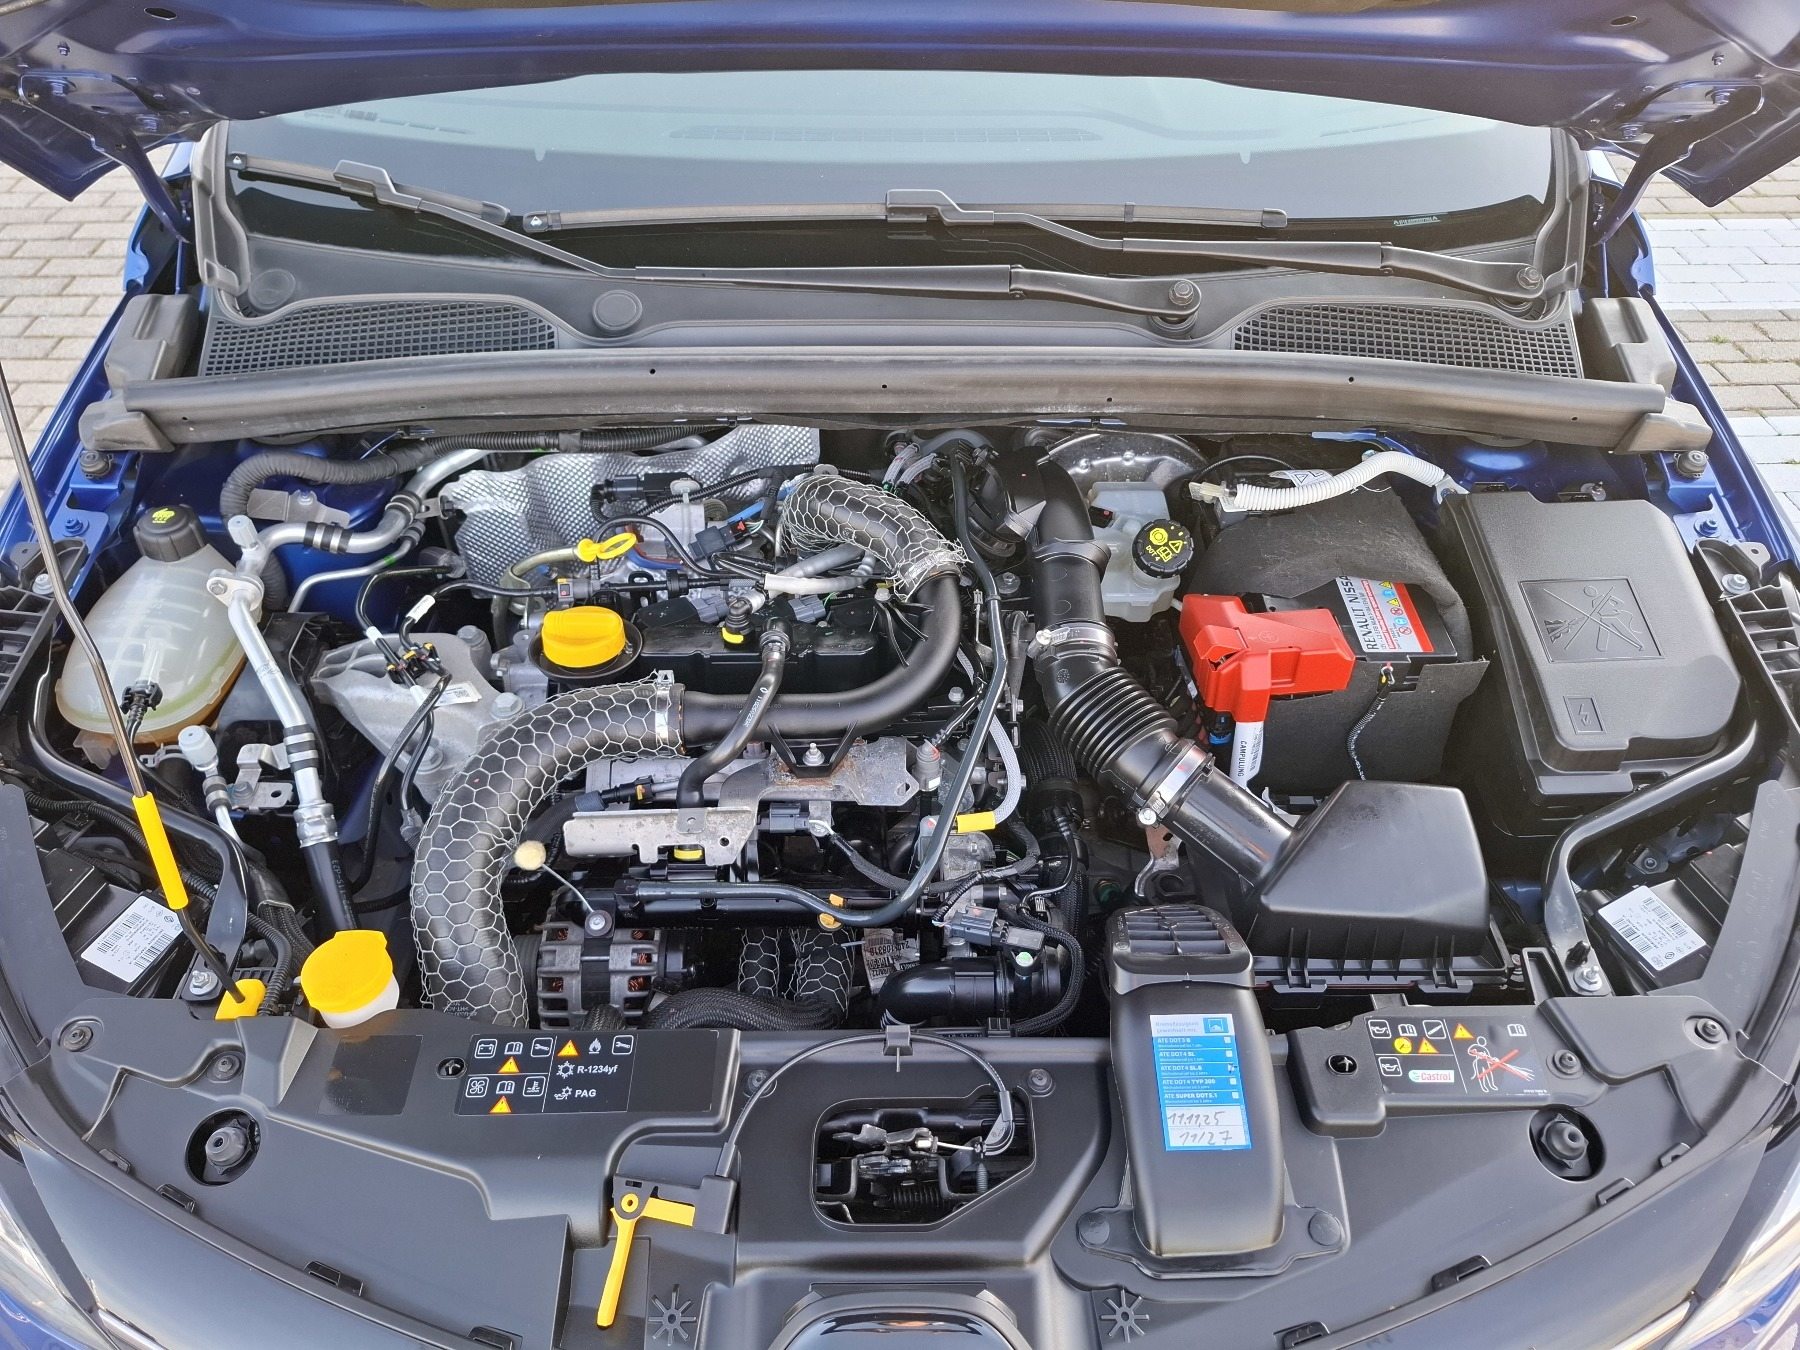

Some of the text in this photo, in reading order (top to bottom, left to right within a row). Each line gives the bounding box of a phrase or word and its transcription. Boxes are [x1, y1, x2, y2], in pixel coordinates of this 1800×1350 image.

[1146, 545, 1157, 556] DOT
[1339, 576, 1359, 603] NISSA
[1351, 606, 1379, 650] RENAULT
[1238, 740, 1247, 777] CAMPULUNG
[577, 1065, 618, 1075] R-1234yf
[1421, 1071, 1451, 1081] Castrol
[575, 1089, 597, 1098] PAG
